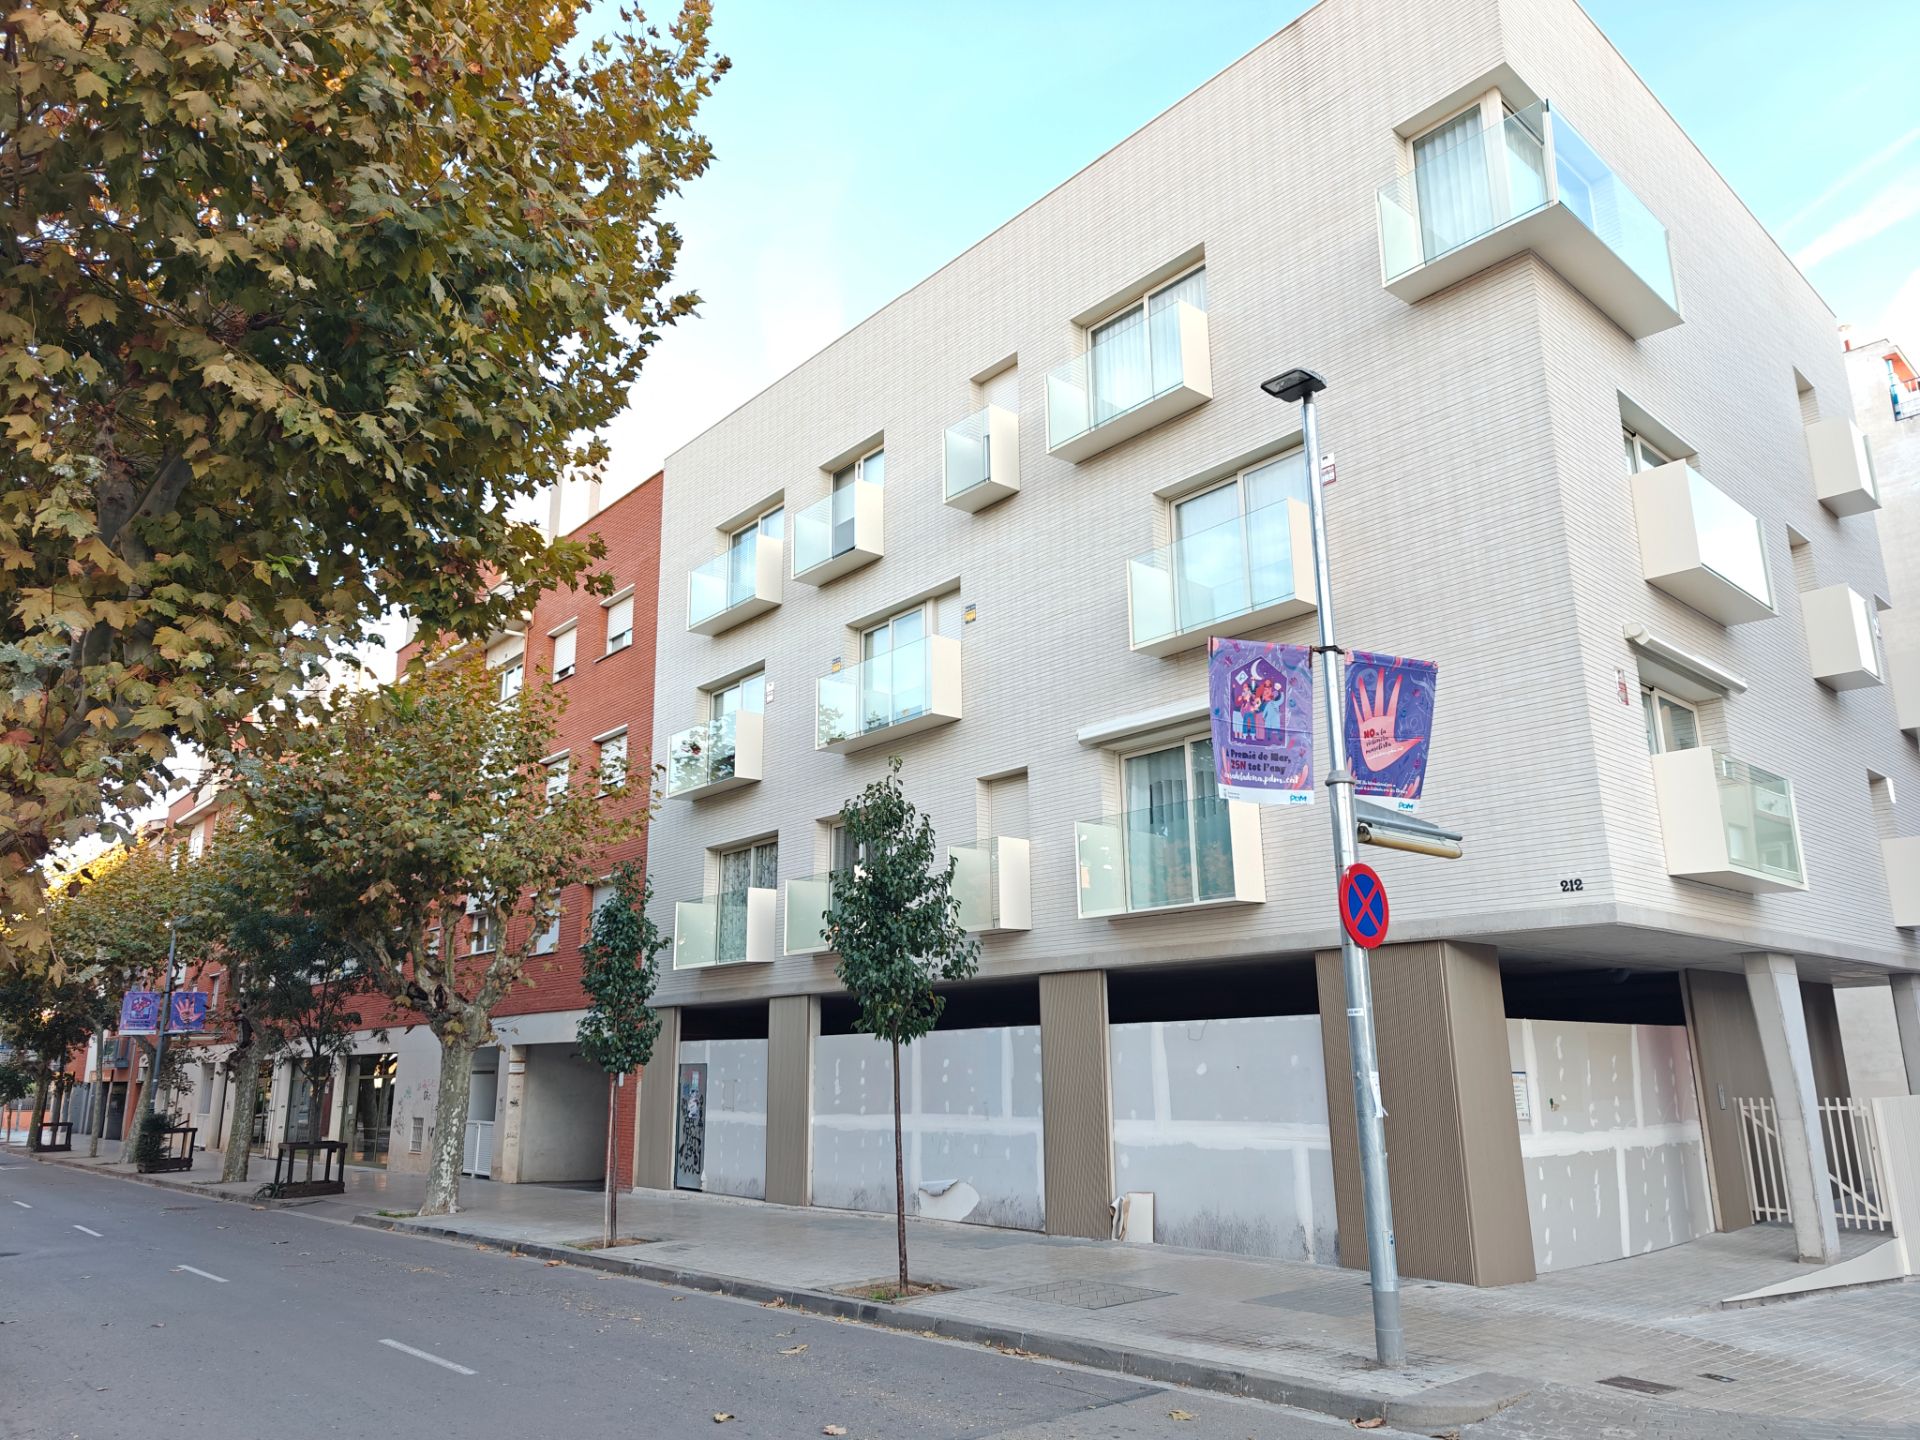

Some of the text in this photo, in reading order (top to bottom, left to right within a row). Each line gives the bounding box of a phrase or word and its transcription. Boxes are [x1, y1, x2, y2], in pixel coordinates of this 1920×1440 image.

[1363, 729, 1375, 738] NO
[1258, 751, 1269, 761] de
[1271, 753, 1291, 763] Mar,
[1230, 759, 1247, 770] 25N
[1247, 762, 1262, 772] tot
[1560, 878, 1583, 892] 212
